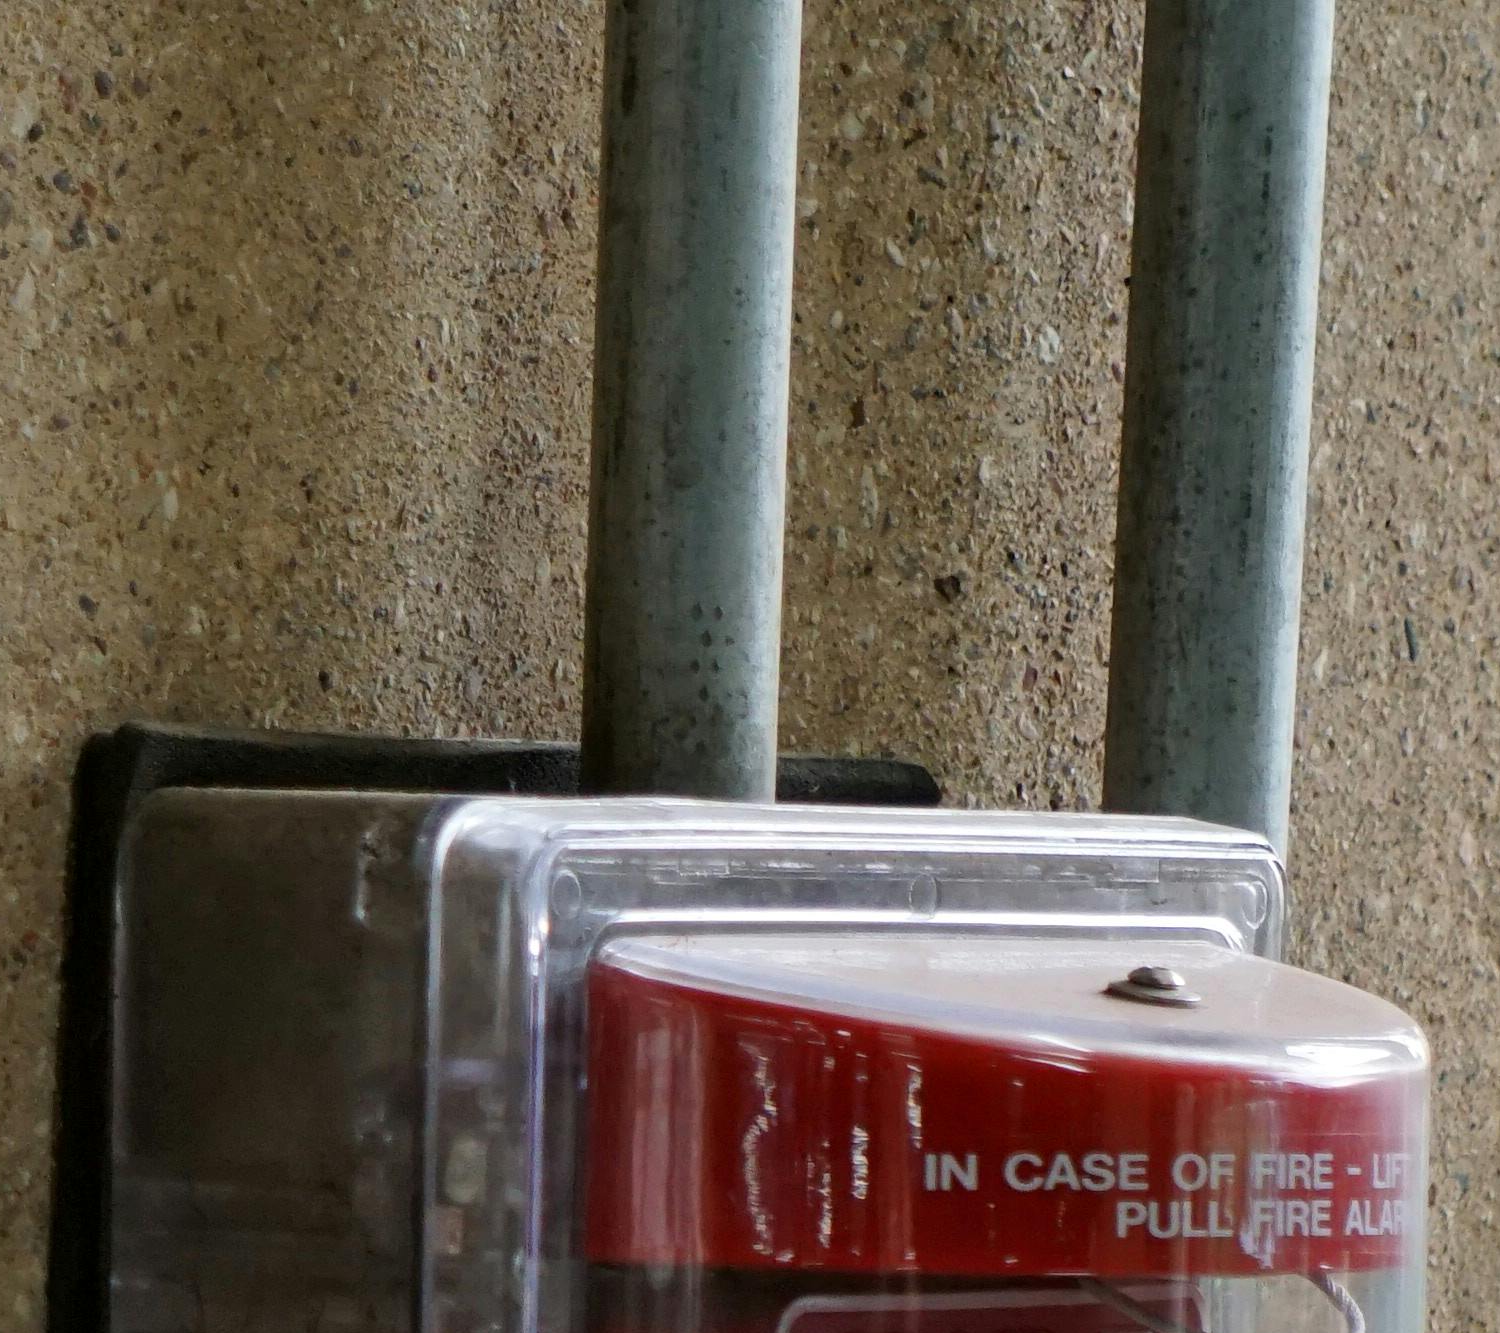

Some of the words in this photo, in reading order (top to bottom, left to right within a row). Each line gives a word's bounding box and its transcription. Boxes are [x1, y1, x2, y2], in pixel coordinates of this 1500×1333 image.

[923, 1152, 978, 1192] IN
[1004, 1152, 1149, 1192] CASE
[1171, 1152, 1236, 1192] OF
[1252, 1152, 1335, 1191] FIRE
[1116, 1200, 1234, 1240] PULL
[1252, 1200, 1333, 1238] FIRE
